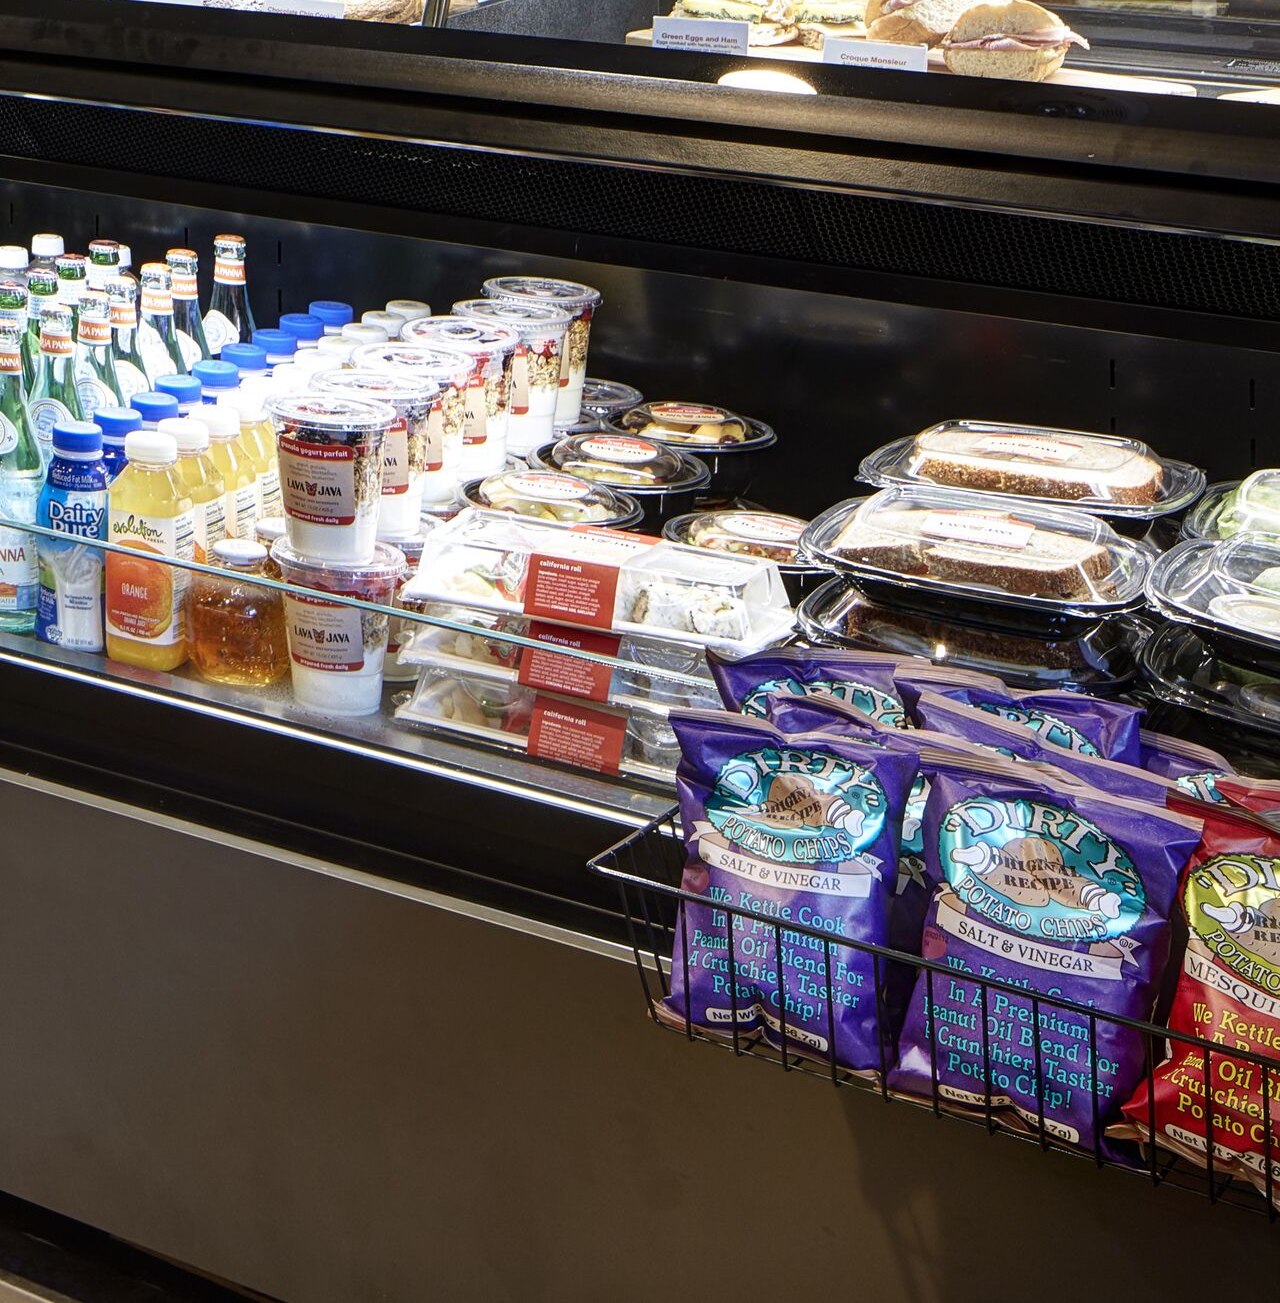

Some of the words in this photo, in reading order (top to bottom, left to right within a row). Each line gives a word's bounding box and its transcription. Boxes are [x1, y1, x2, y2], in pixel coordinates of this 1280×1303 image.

[685, 34, 703, 43] Eggs
[840, 53, 869, 63] Croque
[871, 56, 907, 66] Monsieur
[300, 444, 321, 457] yogurt
[323, 450, 348, 458] parfait
[81, 474, 95, 484] Milk
[287, 478, 305, 491] LAVA
[318, 486, 342, 497] JAVA
[49, 500, 104, 528] Dairy
[52, 519, 99, 541] Pure
[113, 515, 163, 539] evolution
[540, 560, 569, 570] california
[122, 583, 148, 599] ORANGE
[294, 625, 312, 639] LAVA
[326, 632, 349, 643] JAVA
[539, 633, 568, 645] california
[569, 640, 580, 648] roll
[544, 709, 574, 722] california
[575, 717, 587, 726] roll
[720, 815, 785, 857] POTATO
[793, 832, 854, 860] CHIPS
[719, 854, 757, 875] SALT
[759, 868, 769, 879] &
[773, 869, 841, 891] VINEGAR
[991, 854, 1080, 878] ORIGINAL
[1003, 874, 1074, 890] RECIPE
[710, 887, 733, 904] We
[740, 893, 792, 919] Kettle
[798, 906, 846, 934] Cook
[956, 875, 1032, 930] POTATO
[1040, 915, 1108, 939] CHIPS
[741, 941, 767, 958] Oil
[958, 921, 999, 947] SALT
[1001, 939, 1014, 952] &
[1018, 944, 1094, 972] VINEGAR
[1204, 929, 1280, 988] POTATO
[1193, 1003, 1213, 1024] We
[1218, 1060, 1252, 1089] Oil
